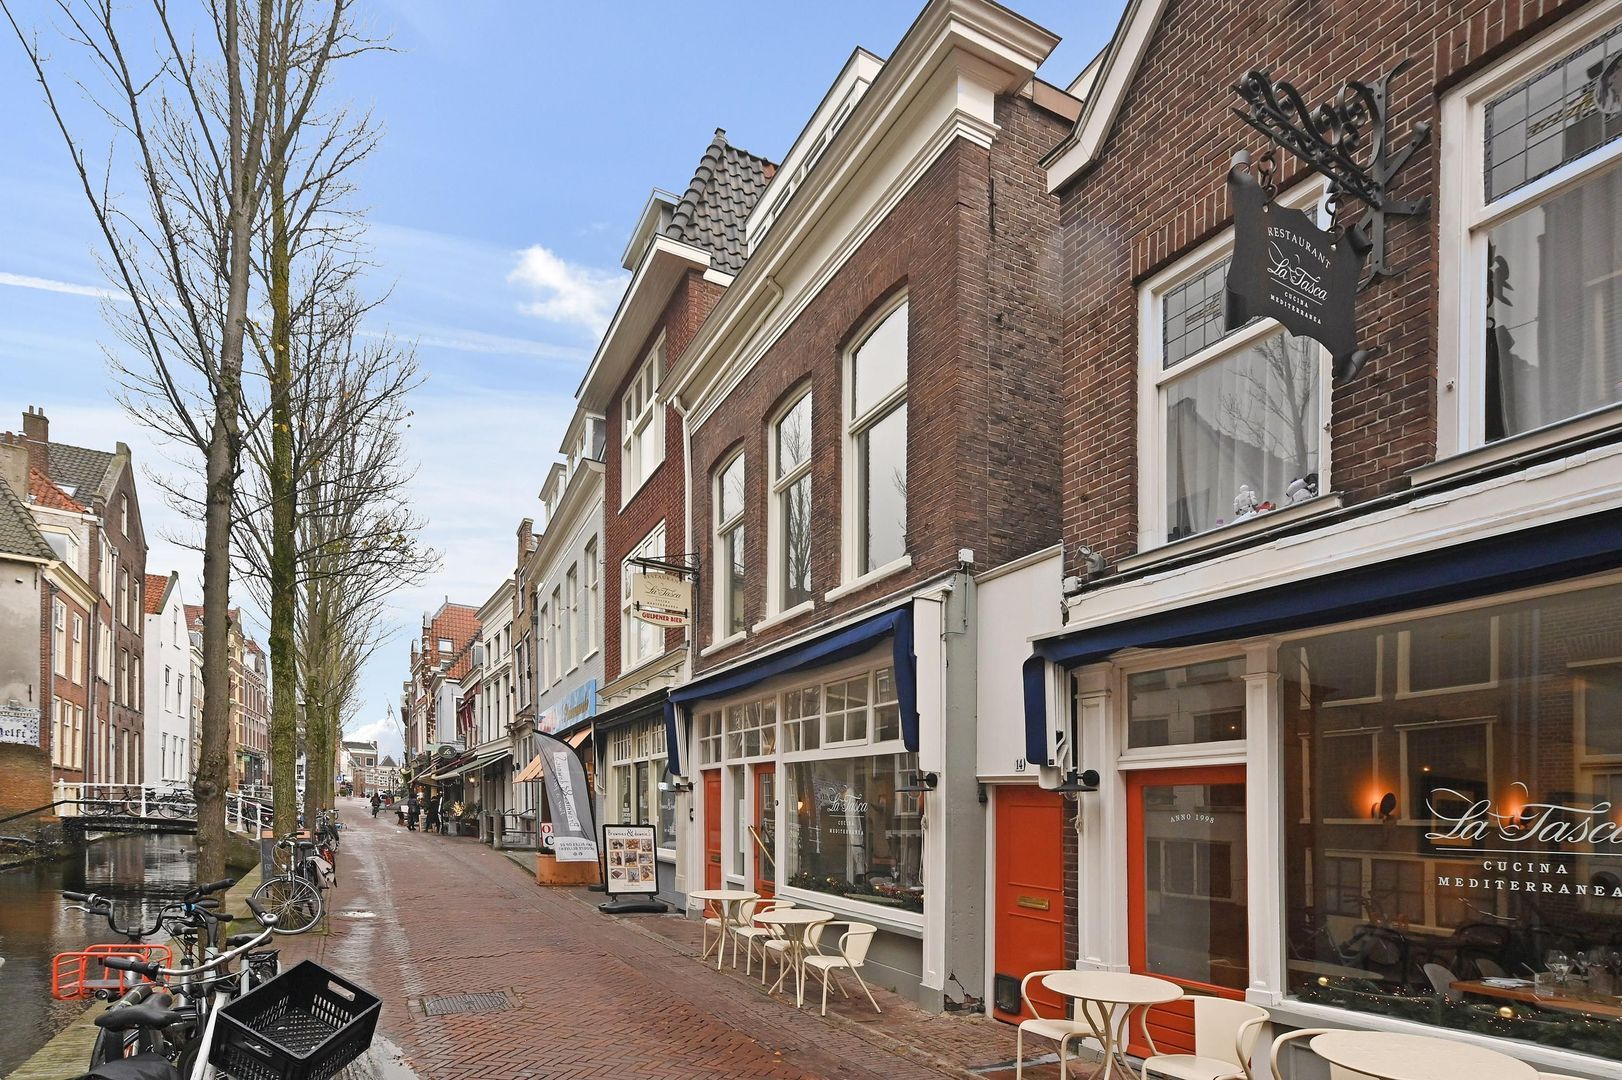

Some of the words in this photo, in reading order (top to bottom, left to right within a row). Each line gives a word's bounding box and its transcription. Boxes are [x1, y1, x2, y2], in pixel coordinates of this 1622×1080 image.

[1267, 226, 1331, 269] RESTAURANT
[1266, 240, 1289, 281] La
[1290, 254, 1328, 301] Tasca
[1269, 293, 1322, 325] MEDITERRANEA
[1284, 291, 1309, 308] CUCINA
[644, 581, 657, 594] La
[658, 583, 682, 598] Tasca
[1015, 758, 1023, 770] 14
[827, 788, 840, 812] La
[841, 785, 868, 812] Tasca
[1170, 813, 1192, 823] ANNO
[1195, 814, 1215, 824] 1998
[1425, 788, 1491, 841] La
[1483, 861, 1568, 874] CUCINA
[1438, 877, 1622, 897] MEDITERRANEA
